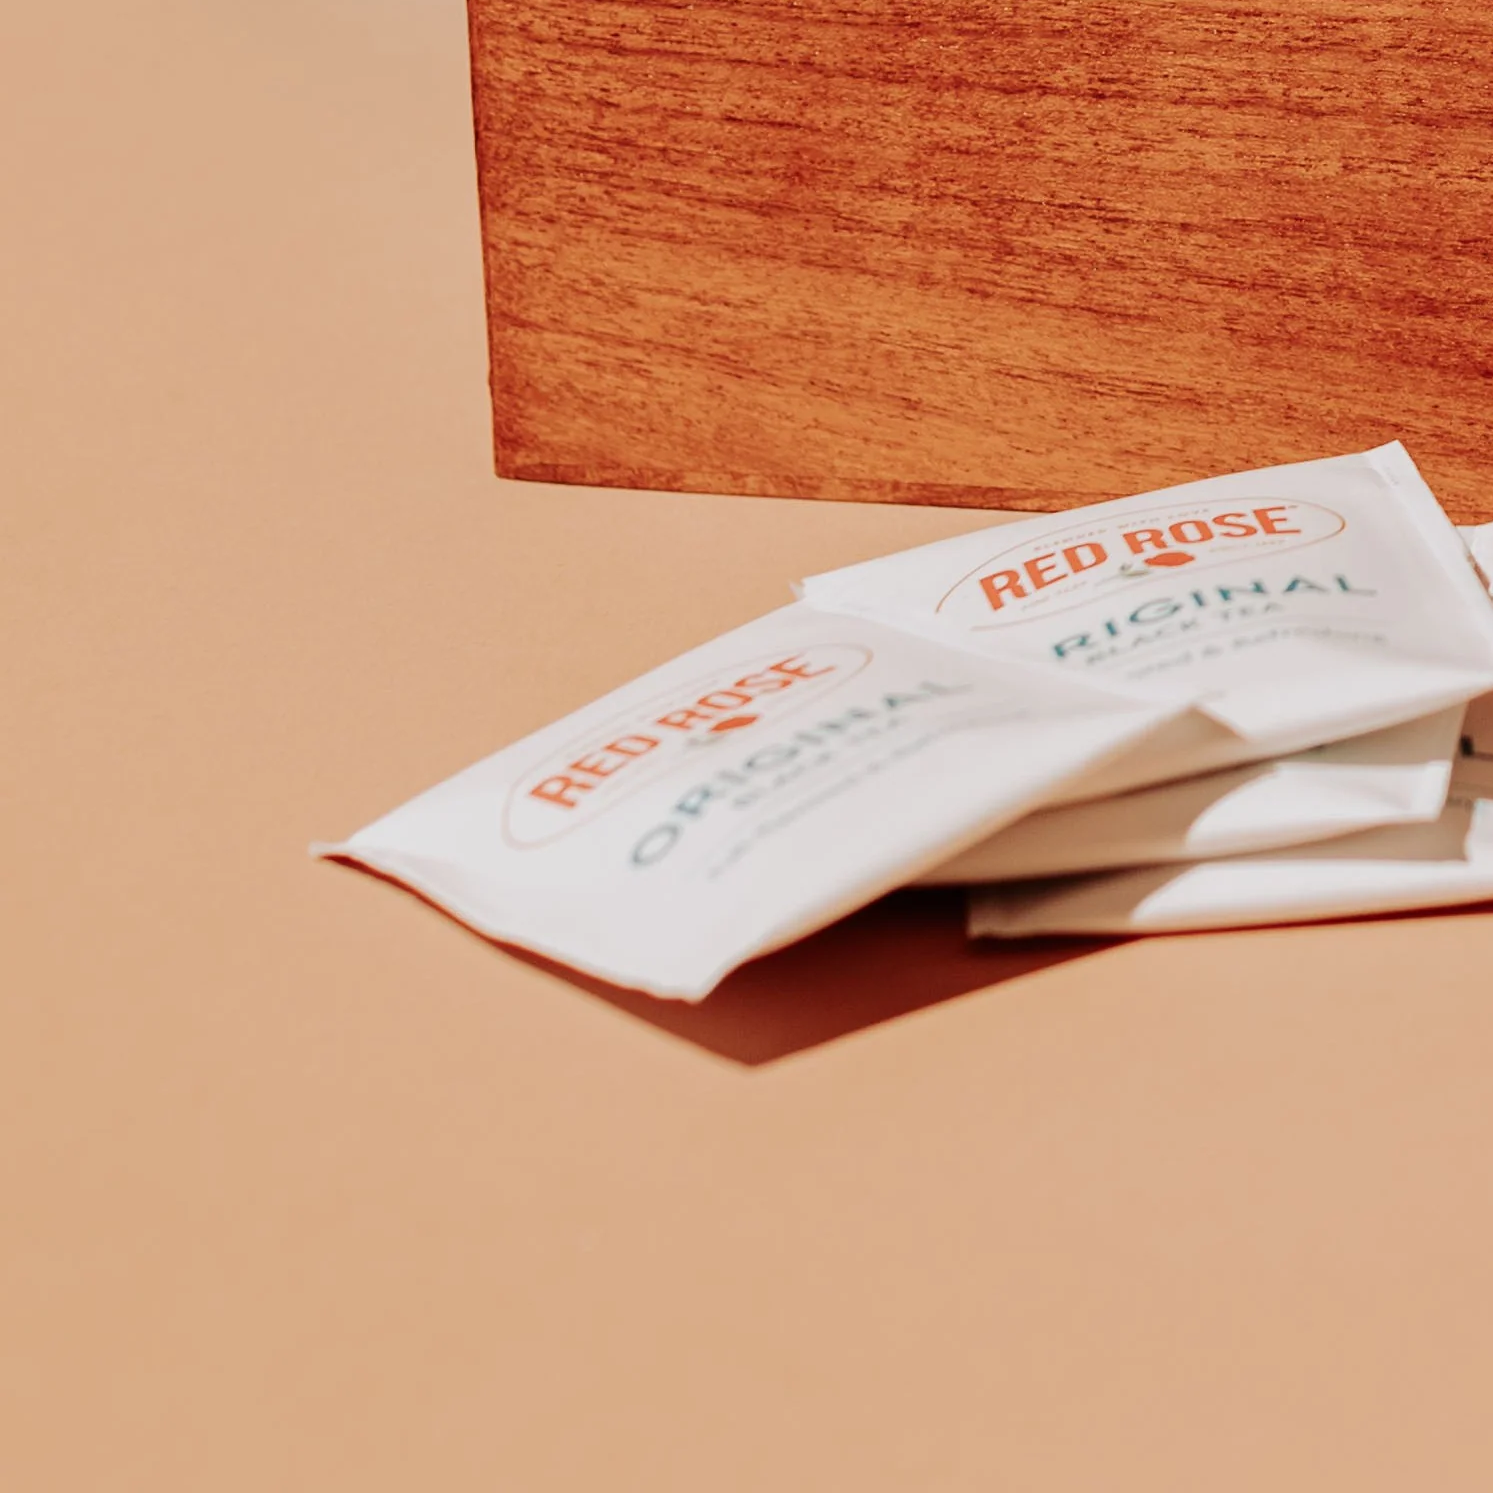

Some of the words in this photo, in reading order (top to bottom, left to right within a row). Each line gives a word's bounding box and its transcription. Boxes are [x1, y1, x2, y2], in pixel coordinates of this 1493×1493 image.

[978, 542, 1108, 612] RED
[1122, 505, 1303, 555] ROSE
[1053, 574, 1378, 657] RIGINAL
[528, 733, 661, 810] RED
[656, 654, 838, 733] ROSE
[628, 679, 974, 870] ORIGINAL
